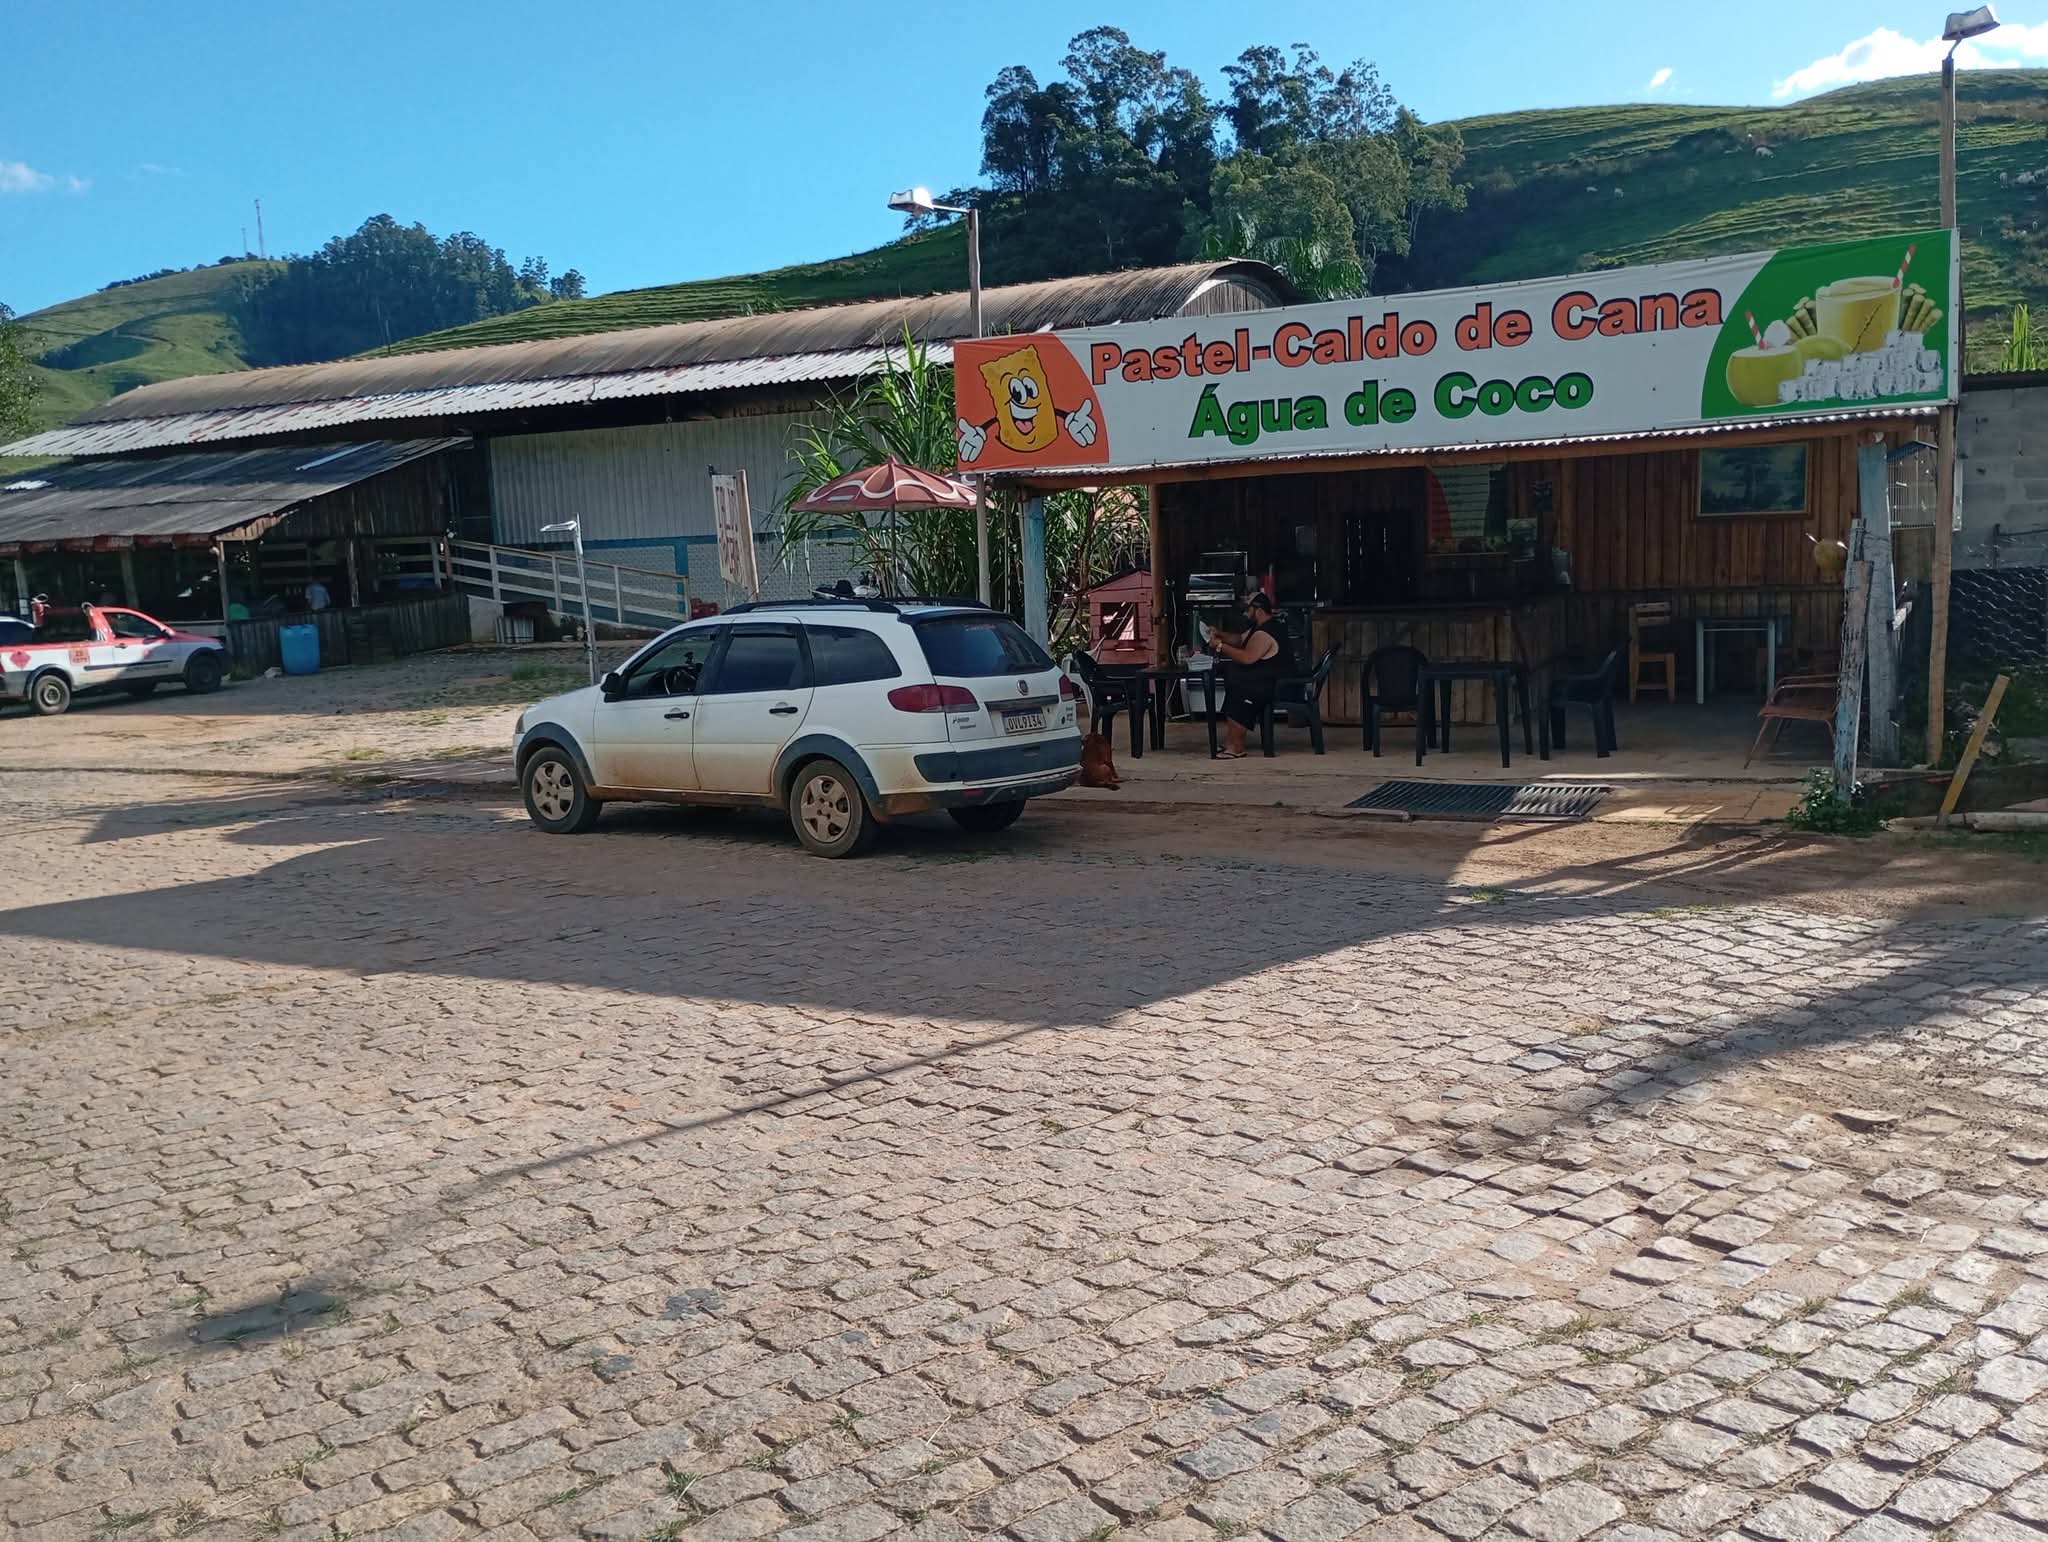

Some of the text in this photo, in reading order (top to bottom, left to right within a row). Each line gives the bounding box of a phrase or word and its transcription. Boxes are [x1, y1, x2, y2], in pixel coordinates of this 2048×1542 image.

[1091, 288, 1724, 385] Pastel-Caldo de Cana
[1188, 371, 1594, 445] Água de Coco
